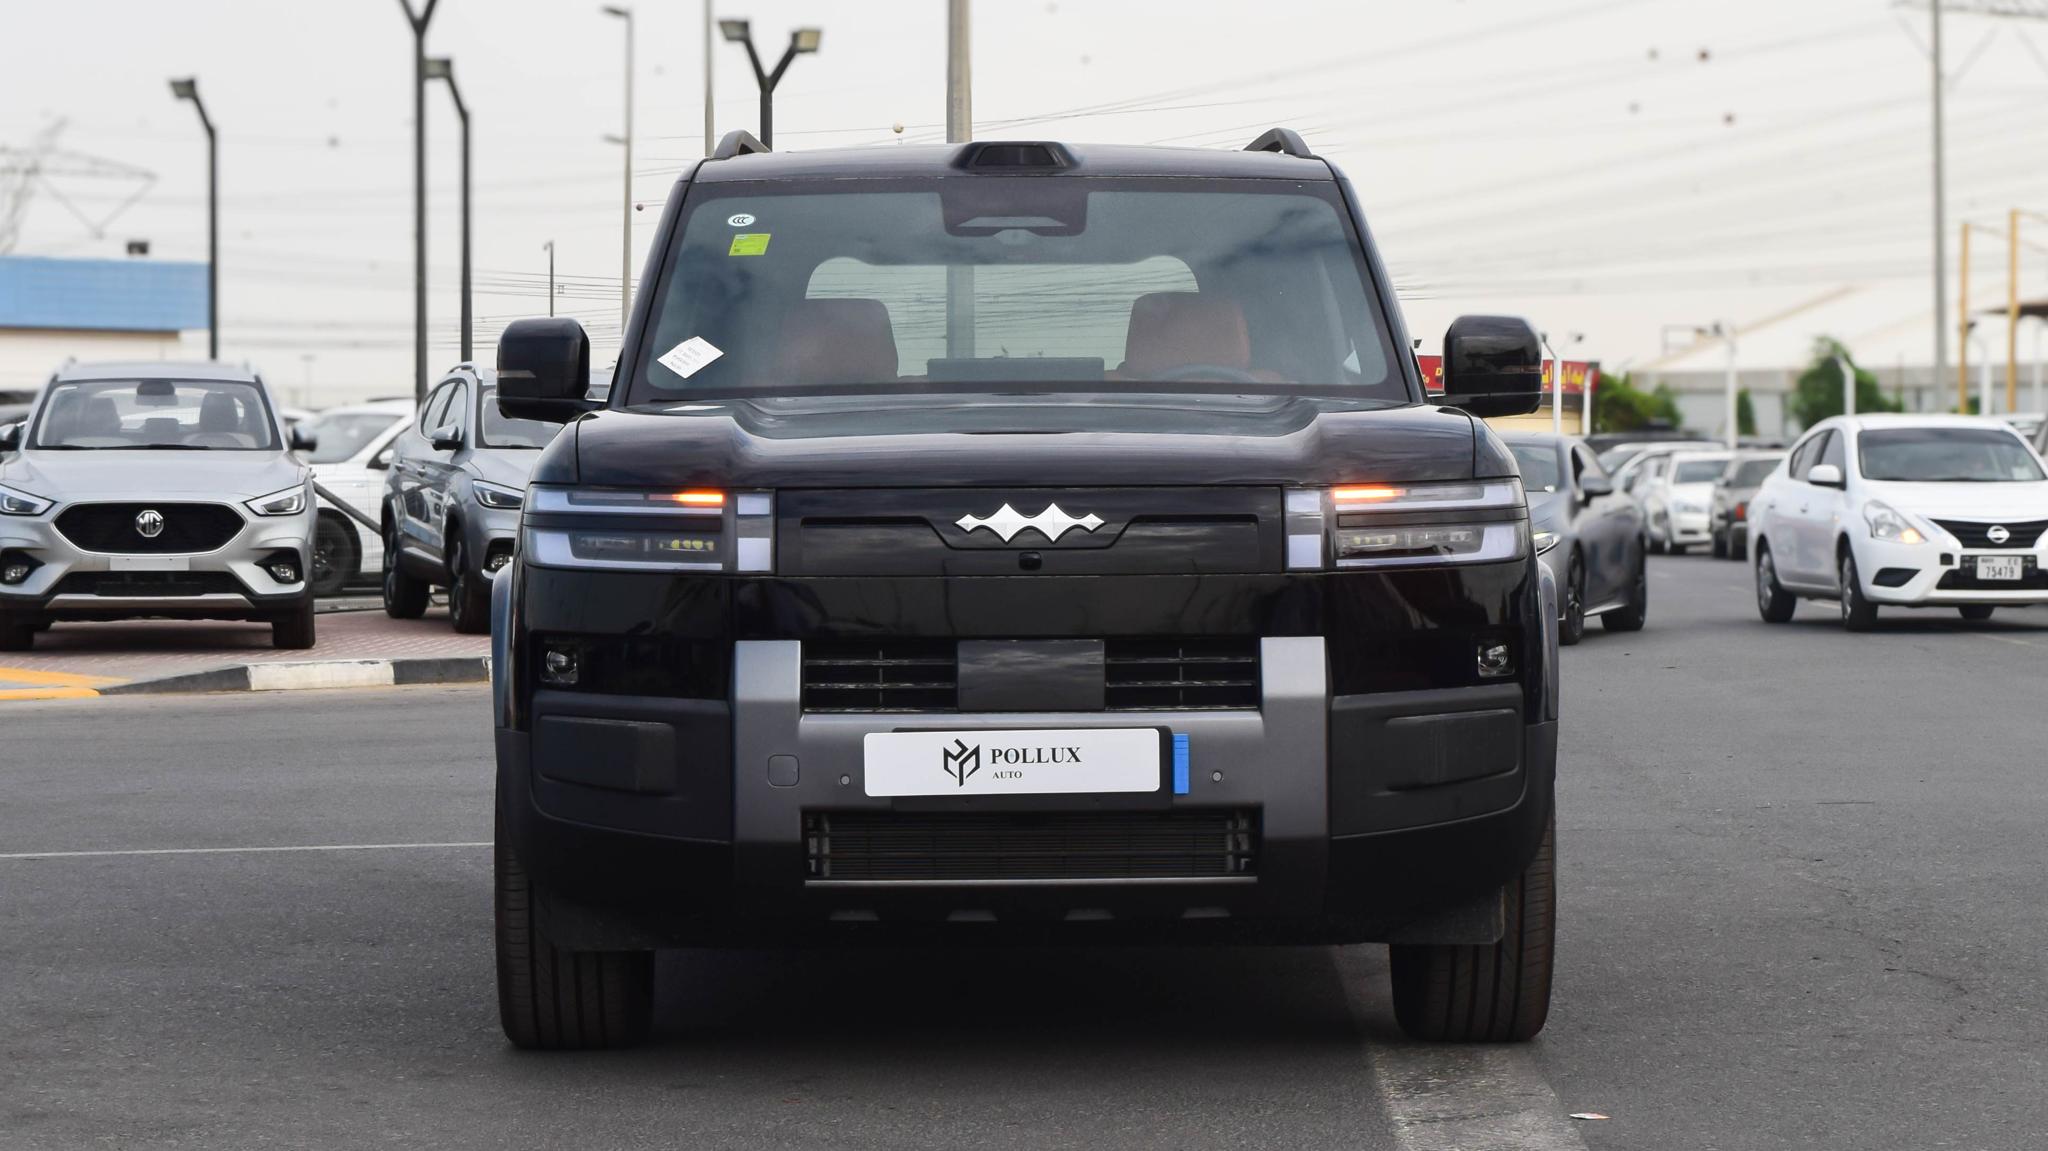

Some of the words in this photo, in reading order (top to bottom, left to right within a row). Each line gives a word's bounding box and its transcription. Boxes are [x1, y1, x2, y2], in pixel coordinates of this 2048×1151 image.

[137, 511, 162, 535] MG
[990, 746, 1082, 765] POLLUX
[992, 770, 1023, 780] AUTO
